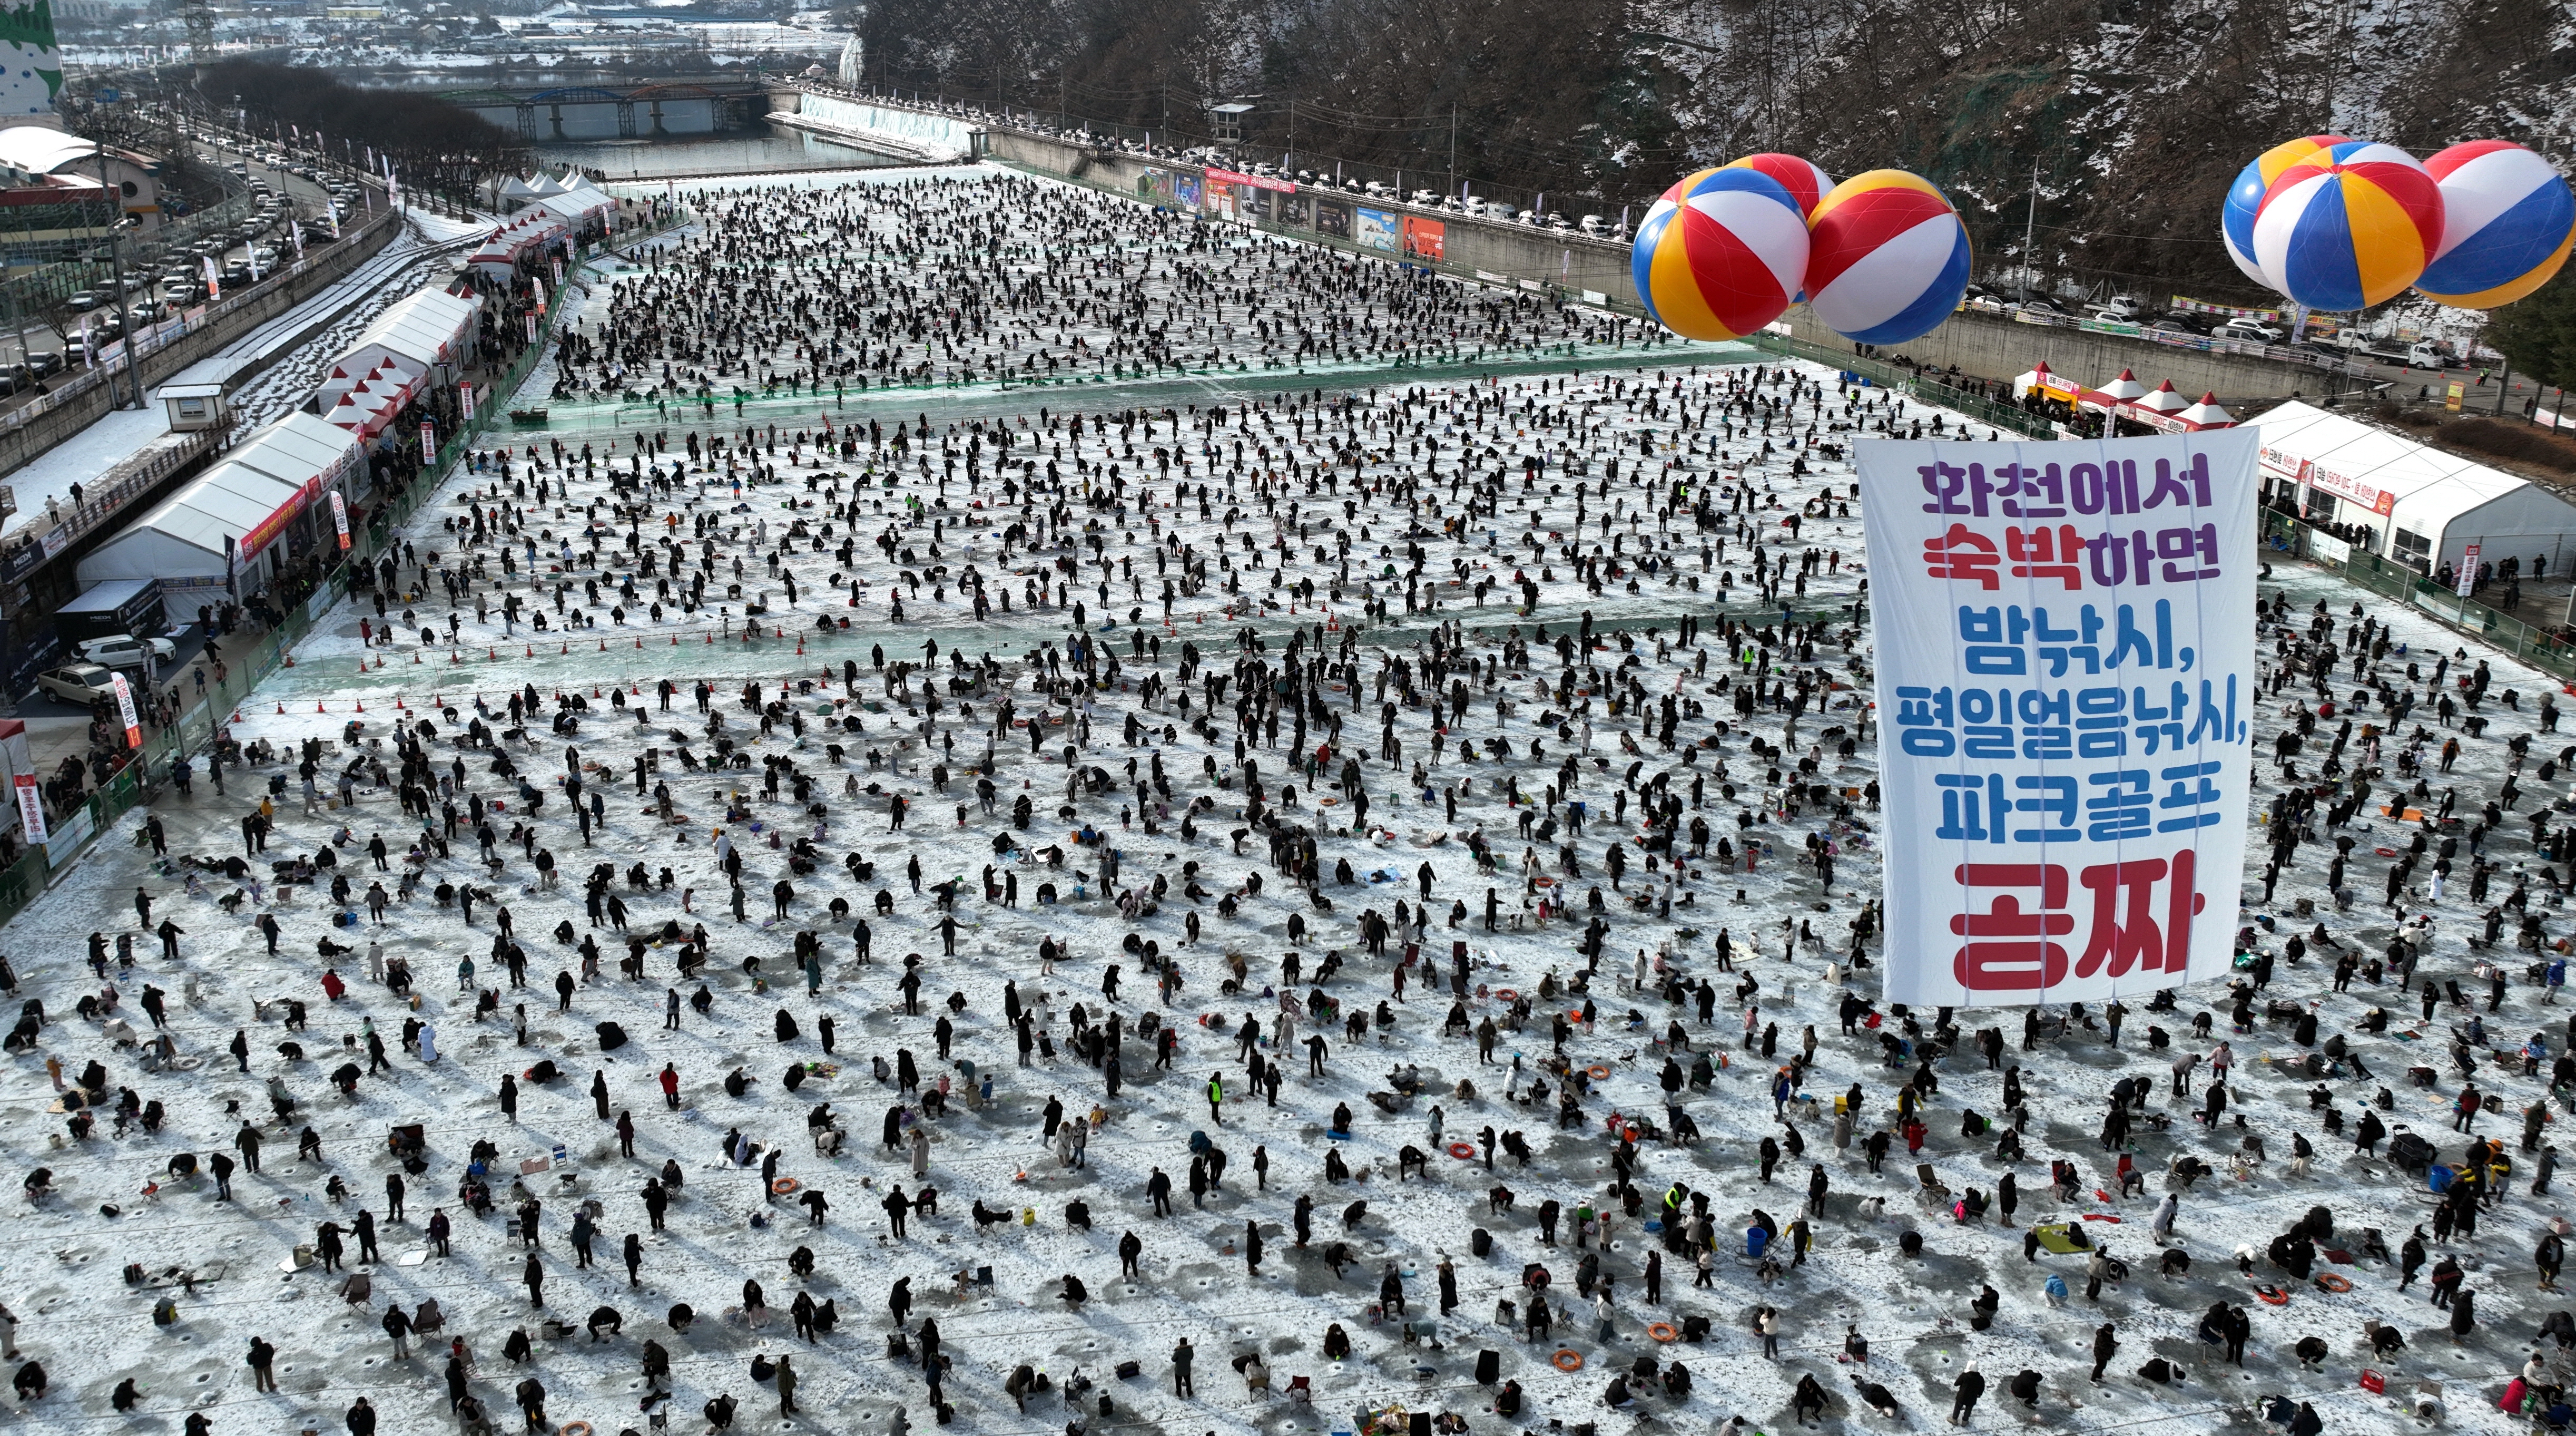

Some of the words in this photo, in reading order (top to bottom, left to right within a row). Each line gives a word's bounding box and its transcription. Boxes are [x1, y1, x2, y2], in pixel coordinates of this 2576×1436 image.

[1917, 452, 2213, 519] 화천에서
[1923, 522, 2221, 591] 숙박하면
[1959, 598, 2195, 678] 밤낚시,
[1896, 672, 2247, 760] 평일얼음낚시,
[1934, 760, 2221, 844] 파크골프
[1950, 848, 2205, 991] 공짜
